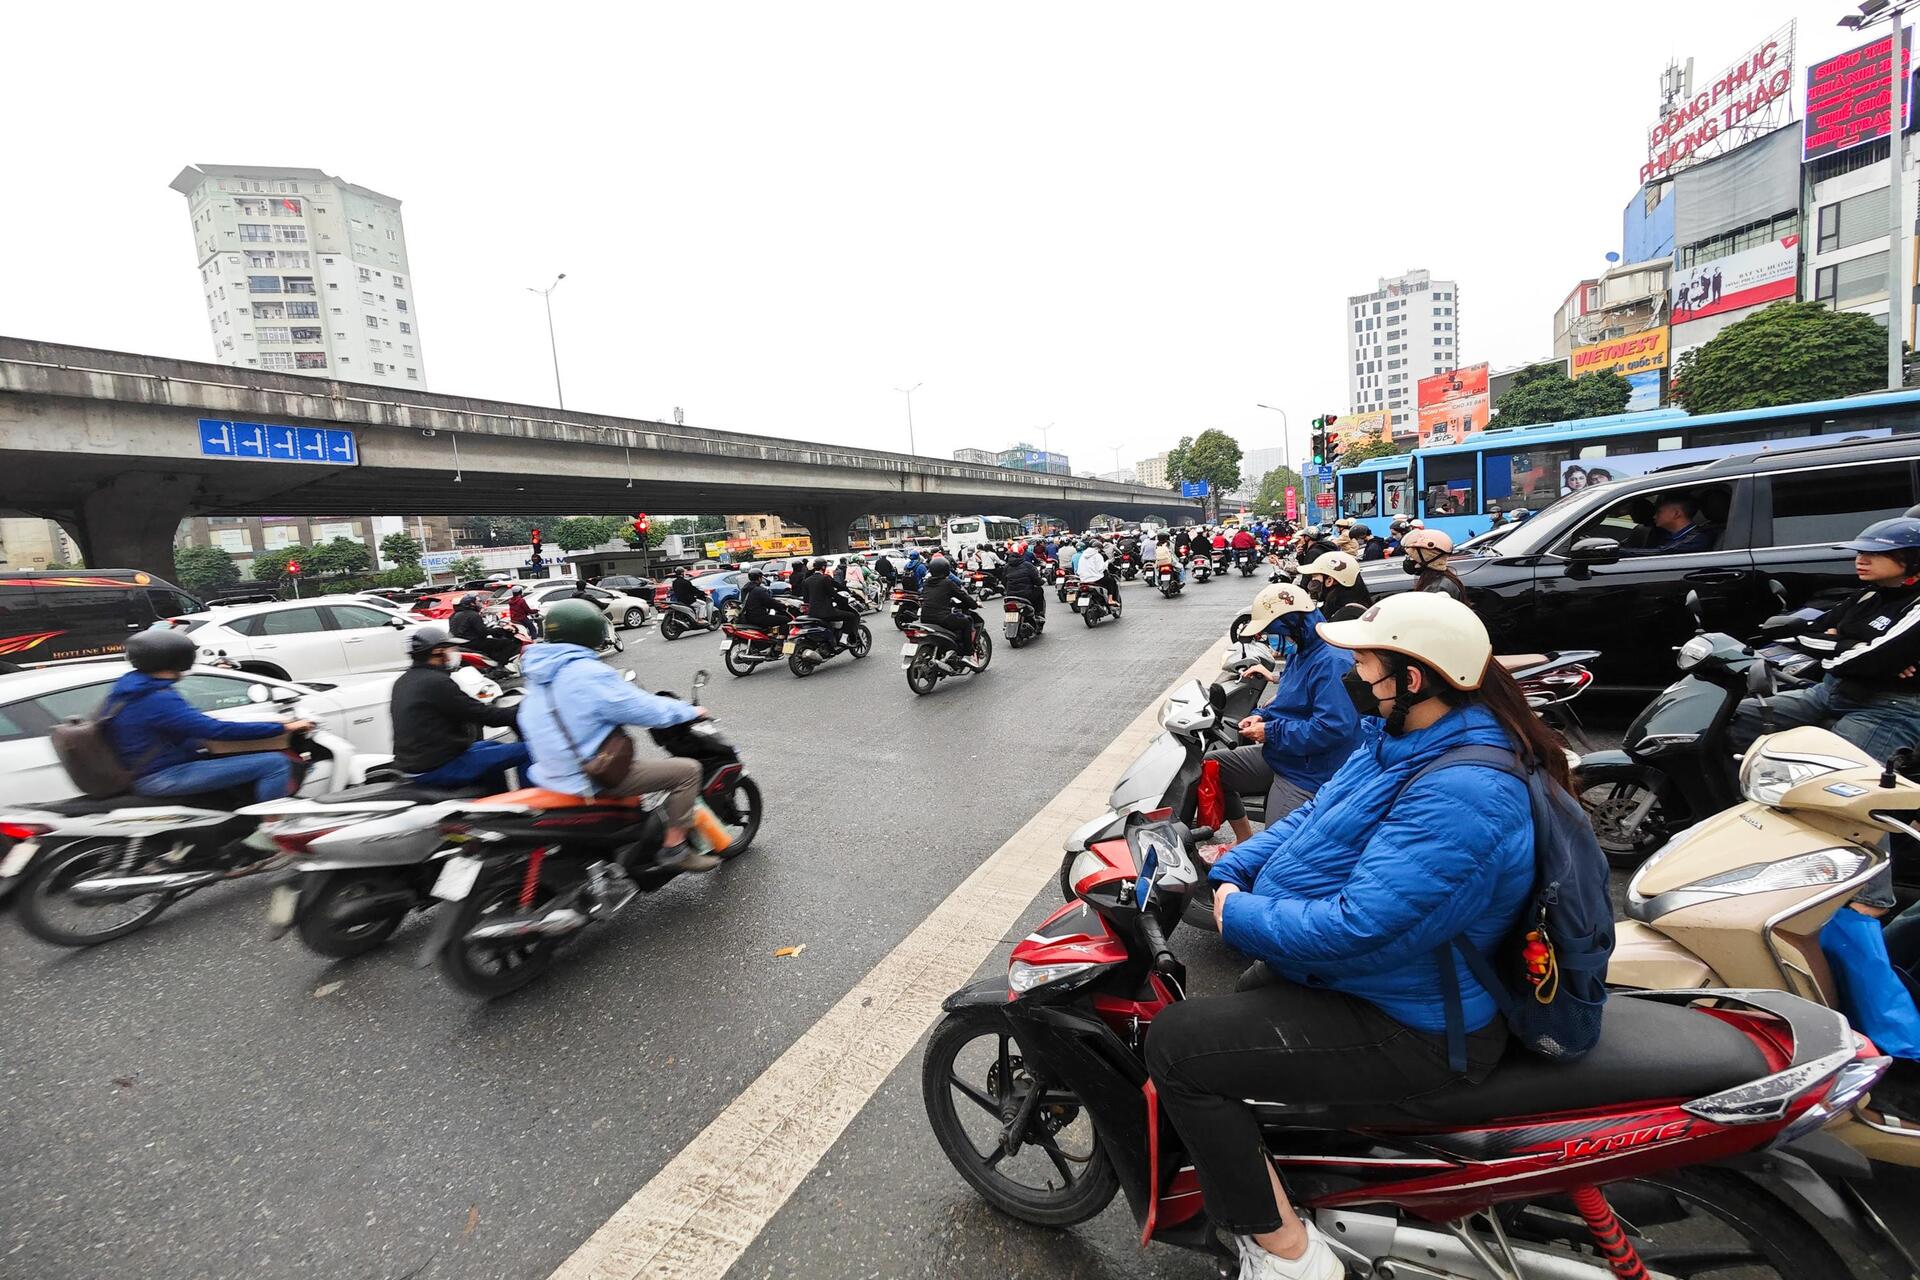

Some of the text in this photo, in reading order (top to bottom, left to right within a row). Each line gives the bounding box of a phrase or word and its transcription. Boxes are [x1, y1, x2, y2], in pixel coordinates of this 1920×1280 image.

[1575, 334, 1660, 367] VIETNEST
[1652, 351, 1665, 366] TẾ
[53, 647, 100, 659] HOTLINE
